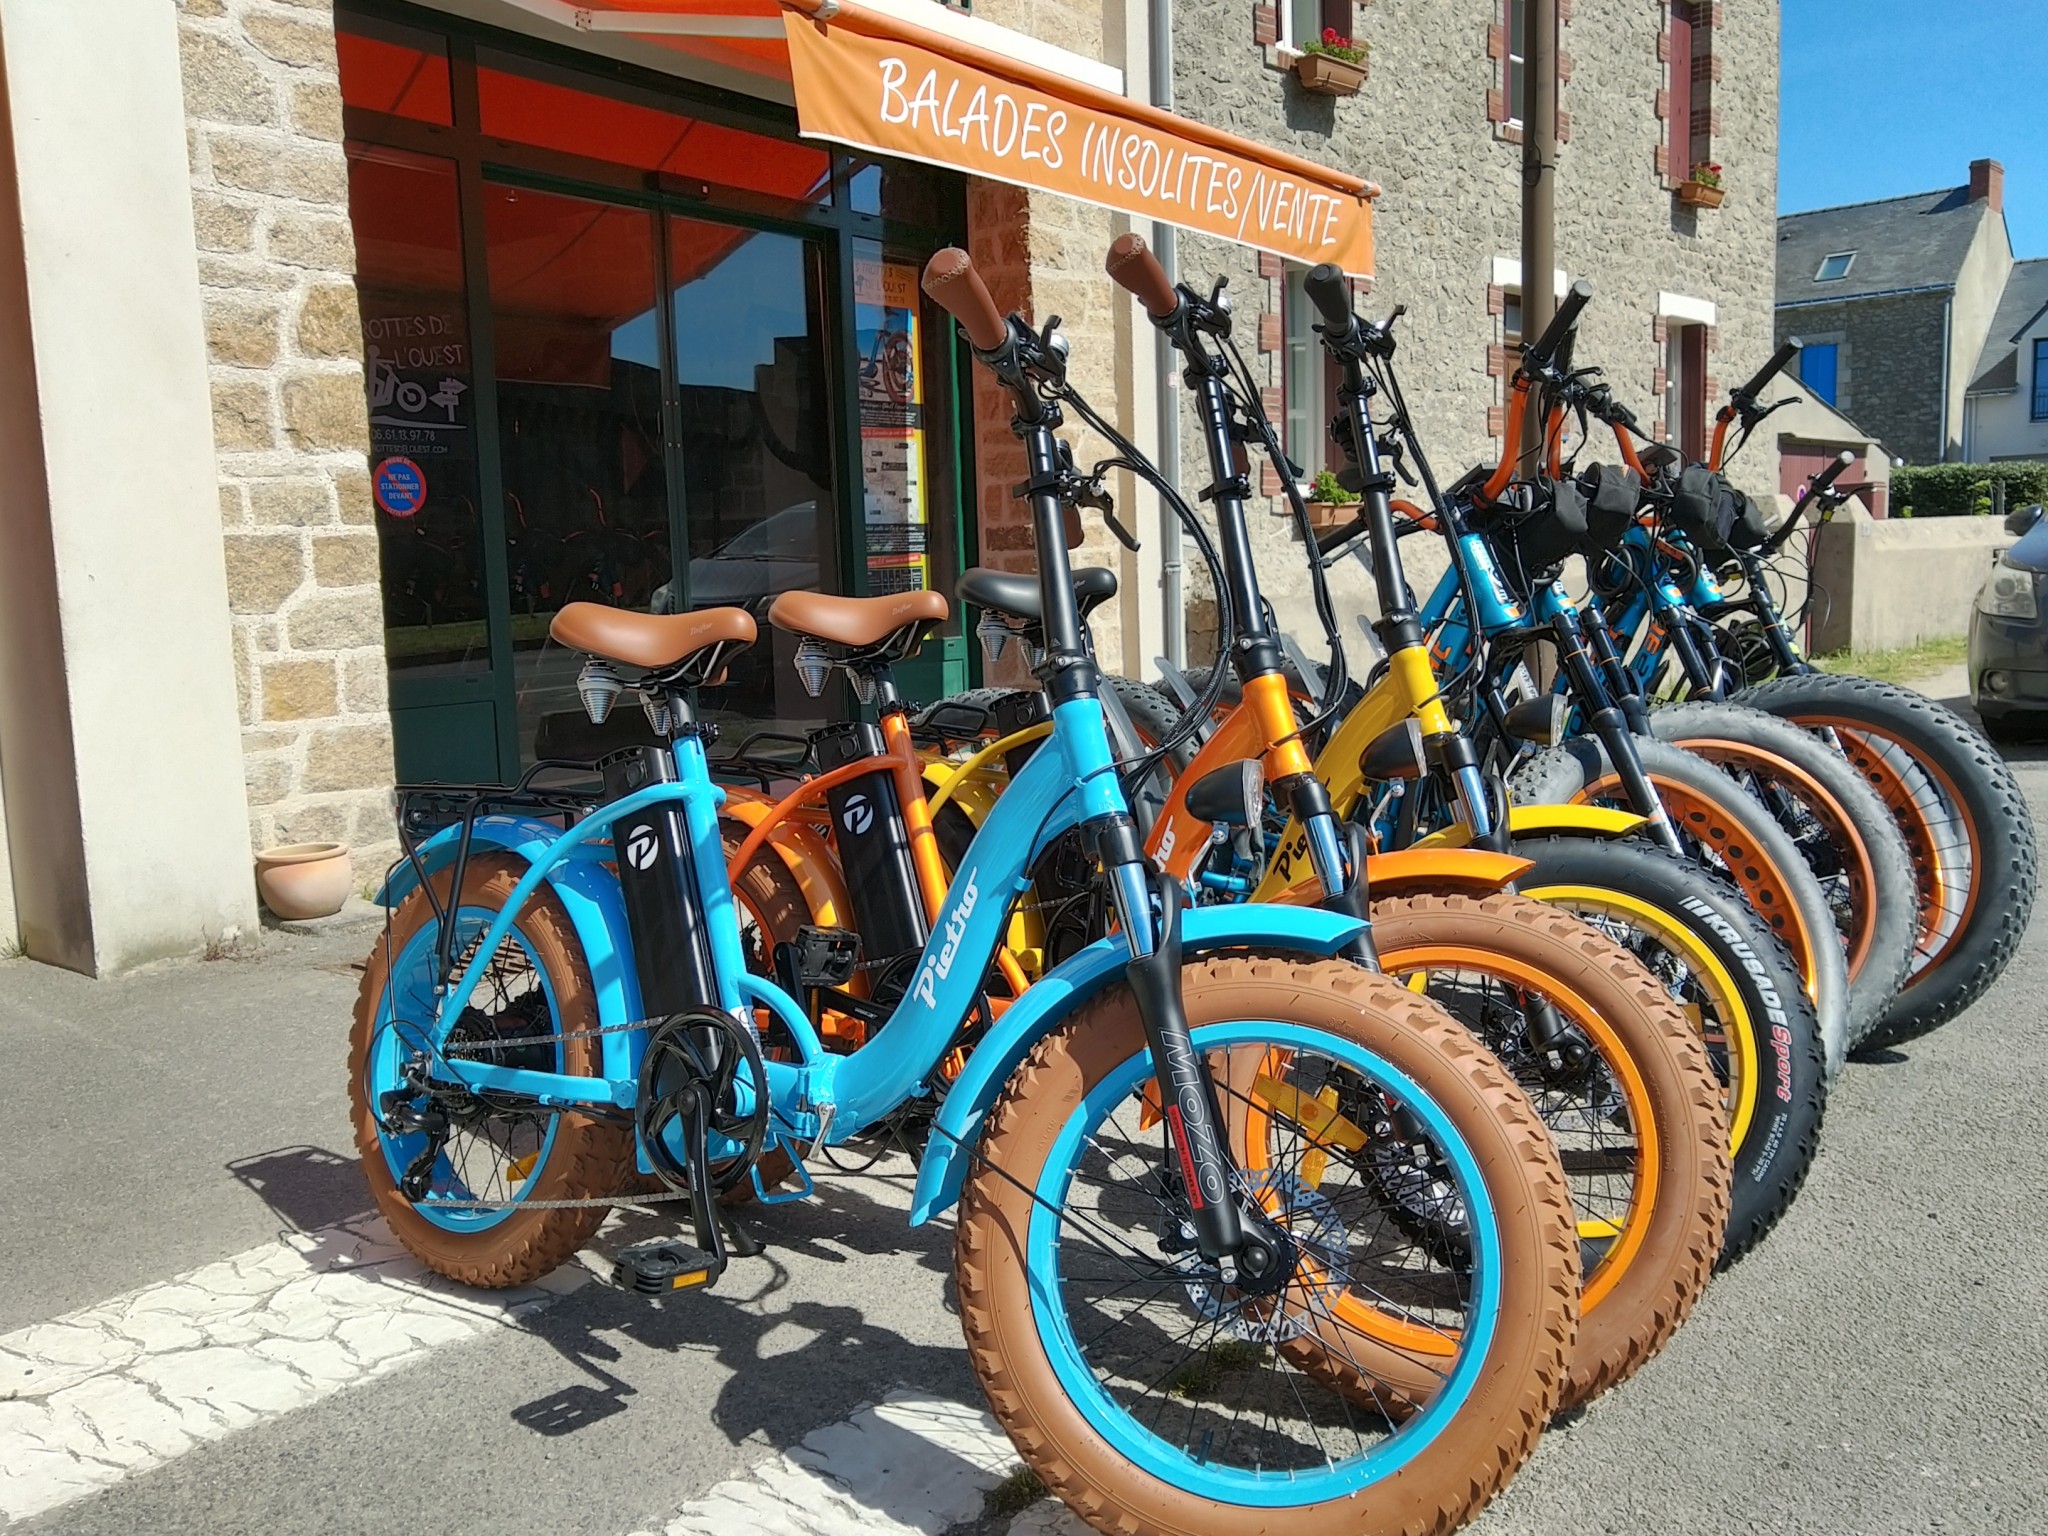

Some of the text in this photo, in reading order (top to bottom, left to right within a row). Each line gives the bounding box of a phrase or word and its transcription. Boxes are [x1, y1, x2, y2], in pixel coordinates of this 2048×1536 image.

[879, 57, 1343, 246] BALADES INSOLITES/VENTE
[429, 315, 454, 335] DE
[394, 343, 463, 370] L'OUEST
[380, 482, 419, 491] STATIONNER
[388, 473, 411, 481] NE PAS
[388, 492, 414, 500] DEVANT
[912, 866, 978, 1010] Pietro
[1703, 907, 1793, 1104] KRUSADE Sport
[1160, 1029, 1225, 1204] MOZO
[1754, 1159, 1771, 1182] CASING
